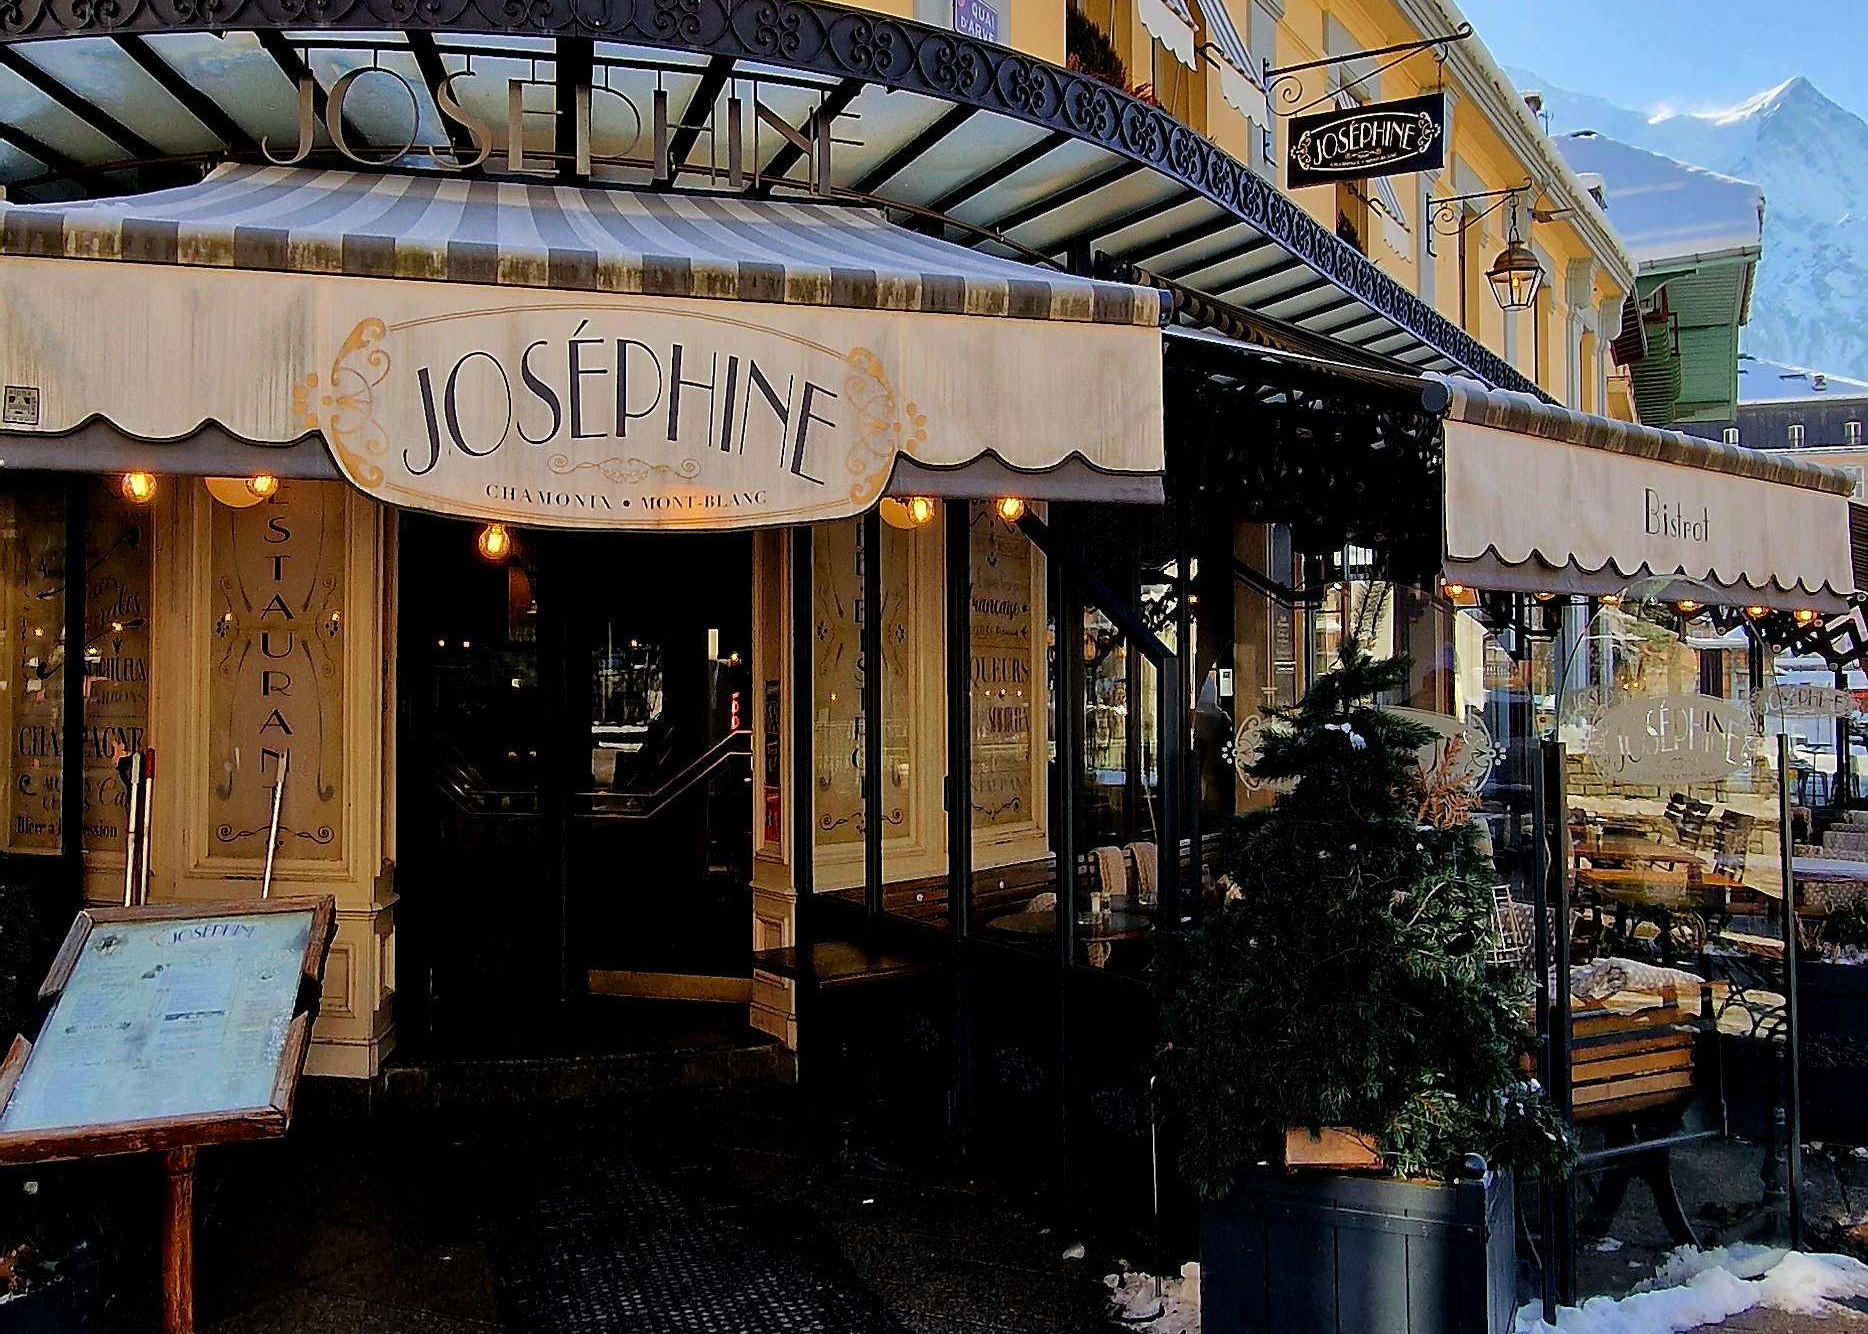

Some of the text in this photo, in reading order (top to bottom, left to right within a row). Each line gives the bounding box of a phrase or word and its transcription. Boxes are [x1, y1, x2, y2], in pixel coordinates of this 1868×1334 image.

[960, 14, 996, 43] D'ARVE
[971, 2, 995, 29] QUAI
[1313, 120, 1416, 165] JOSÉPHINE
[402, 319, 839, 485] JOSÉPHINE
[486, 483, 768, 511] CHAMONIX MONT-BLANC
[1645, 487, 1709, 543] Bistrot
[1615, 699, 1740, 773] JOSÉPHINE
